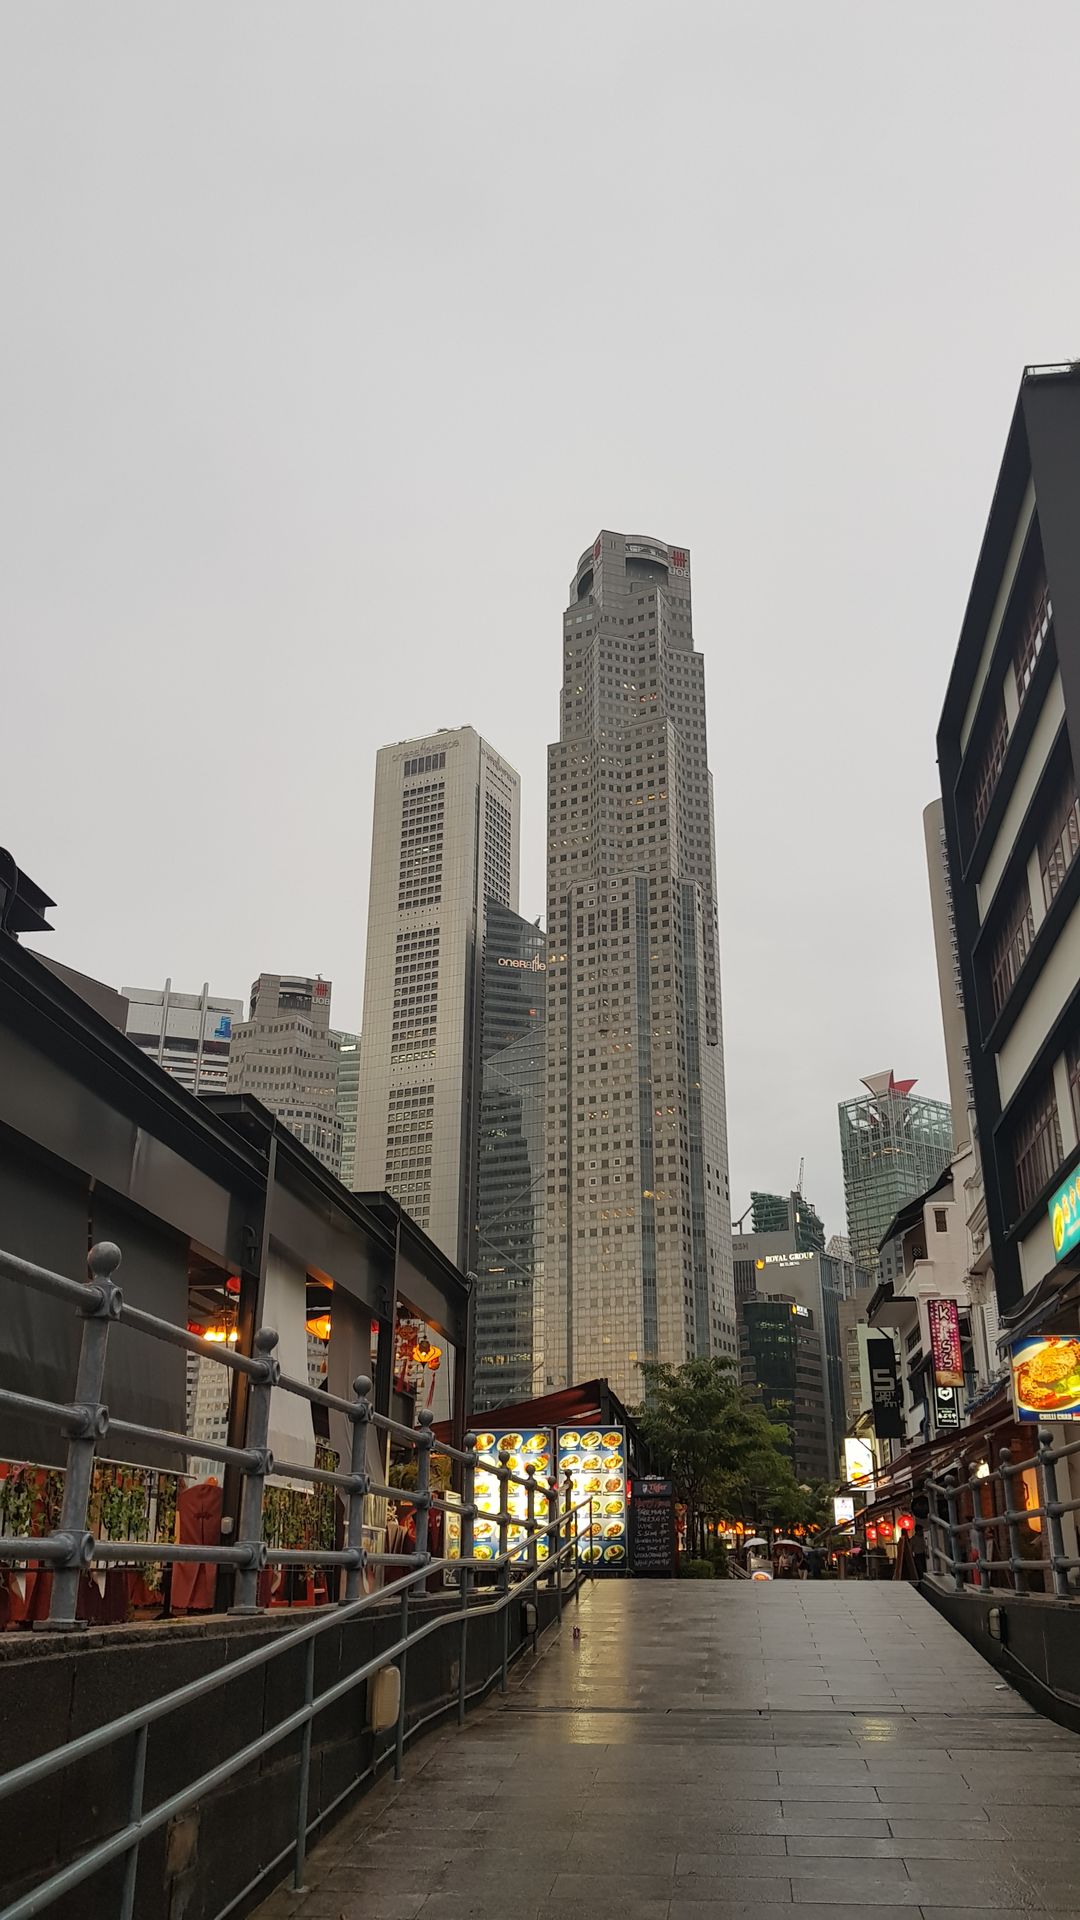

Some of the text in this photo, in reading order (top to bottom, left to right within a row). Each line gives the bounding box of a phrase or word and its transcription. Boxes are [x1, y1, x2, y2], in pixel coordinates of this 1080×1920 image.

[669, 567, 690, 579] UOB
[312, 997, 330, 1005] UOB
[765, 1252, 814, 1263] ROYAL GROUP
